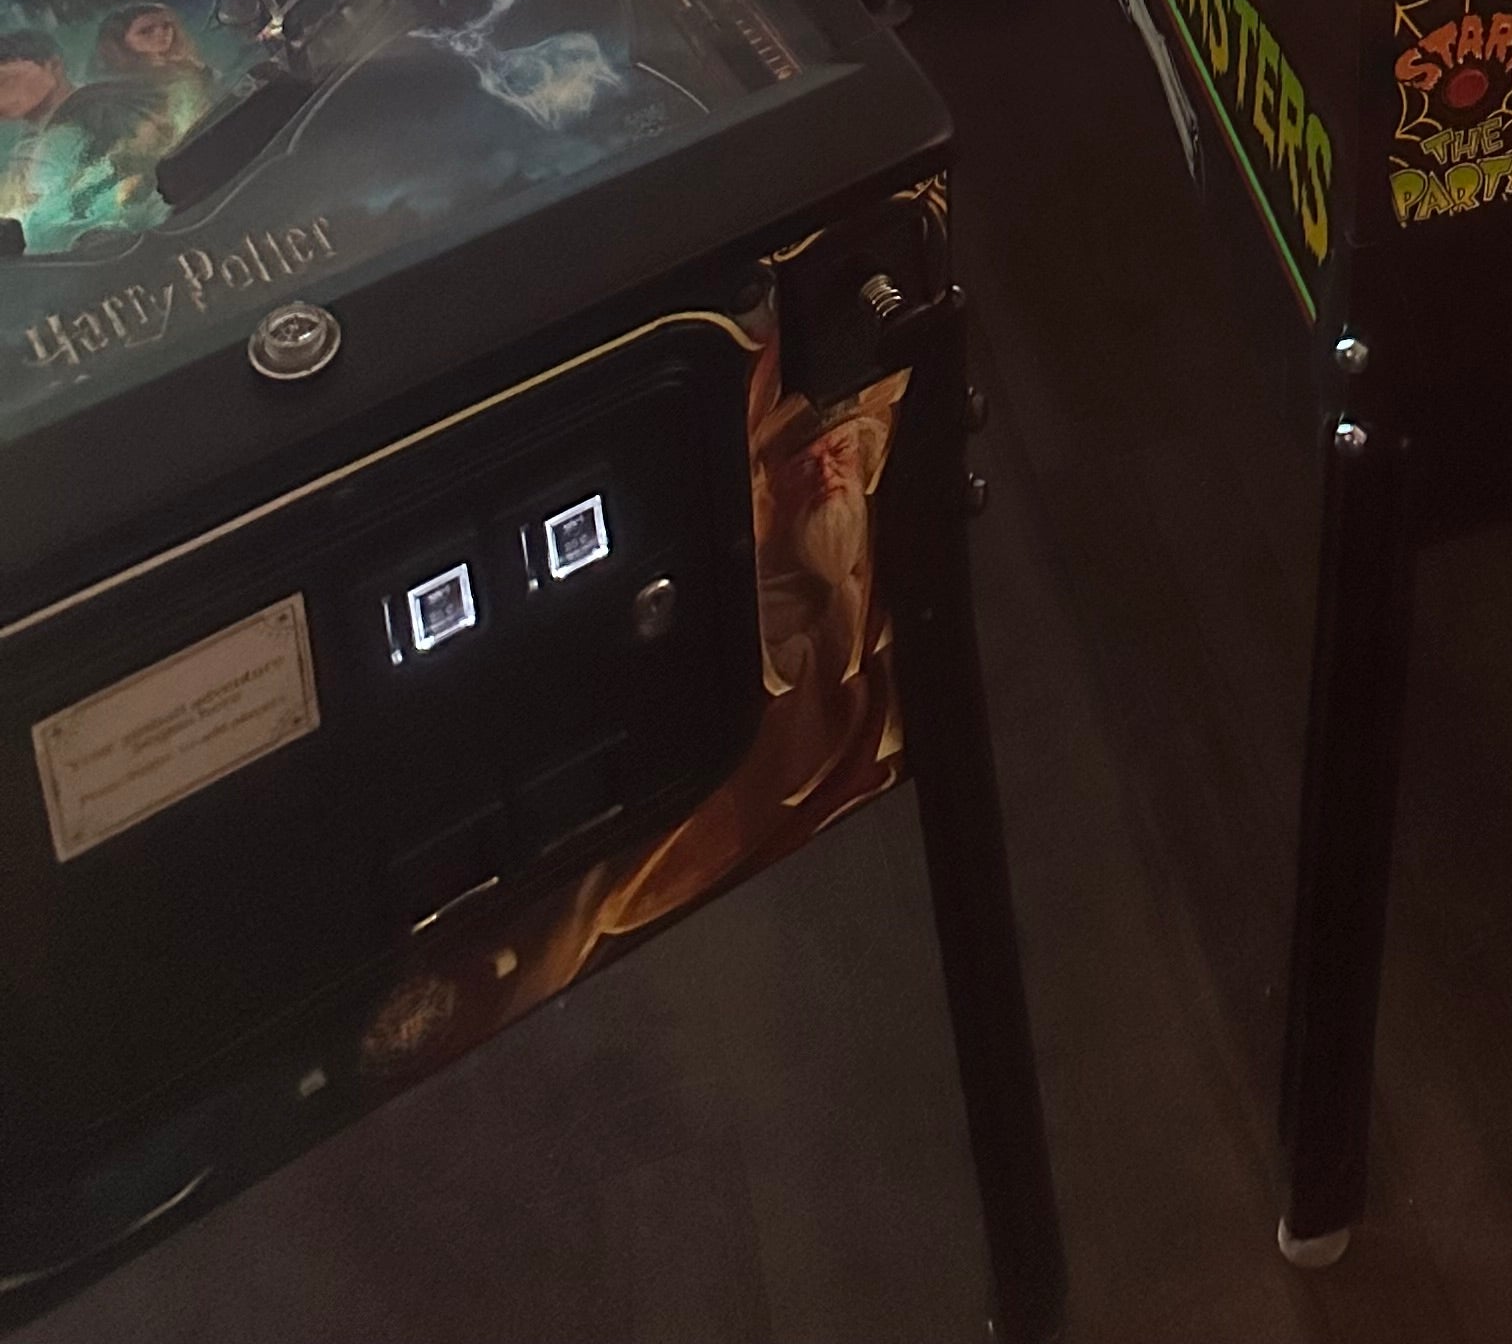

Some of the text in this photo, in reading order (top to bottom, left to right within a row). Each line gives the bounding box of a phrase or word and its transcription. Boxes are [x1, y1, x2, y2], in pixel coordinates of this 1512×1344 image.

[1422, 116, 1505, 165] THE
[24, 215, 337, 364] Harry Potter
